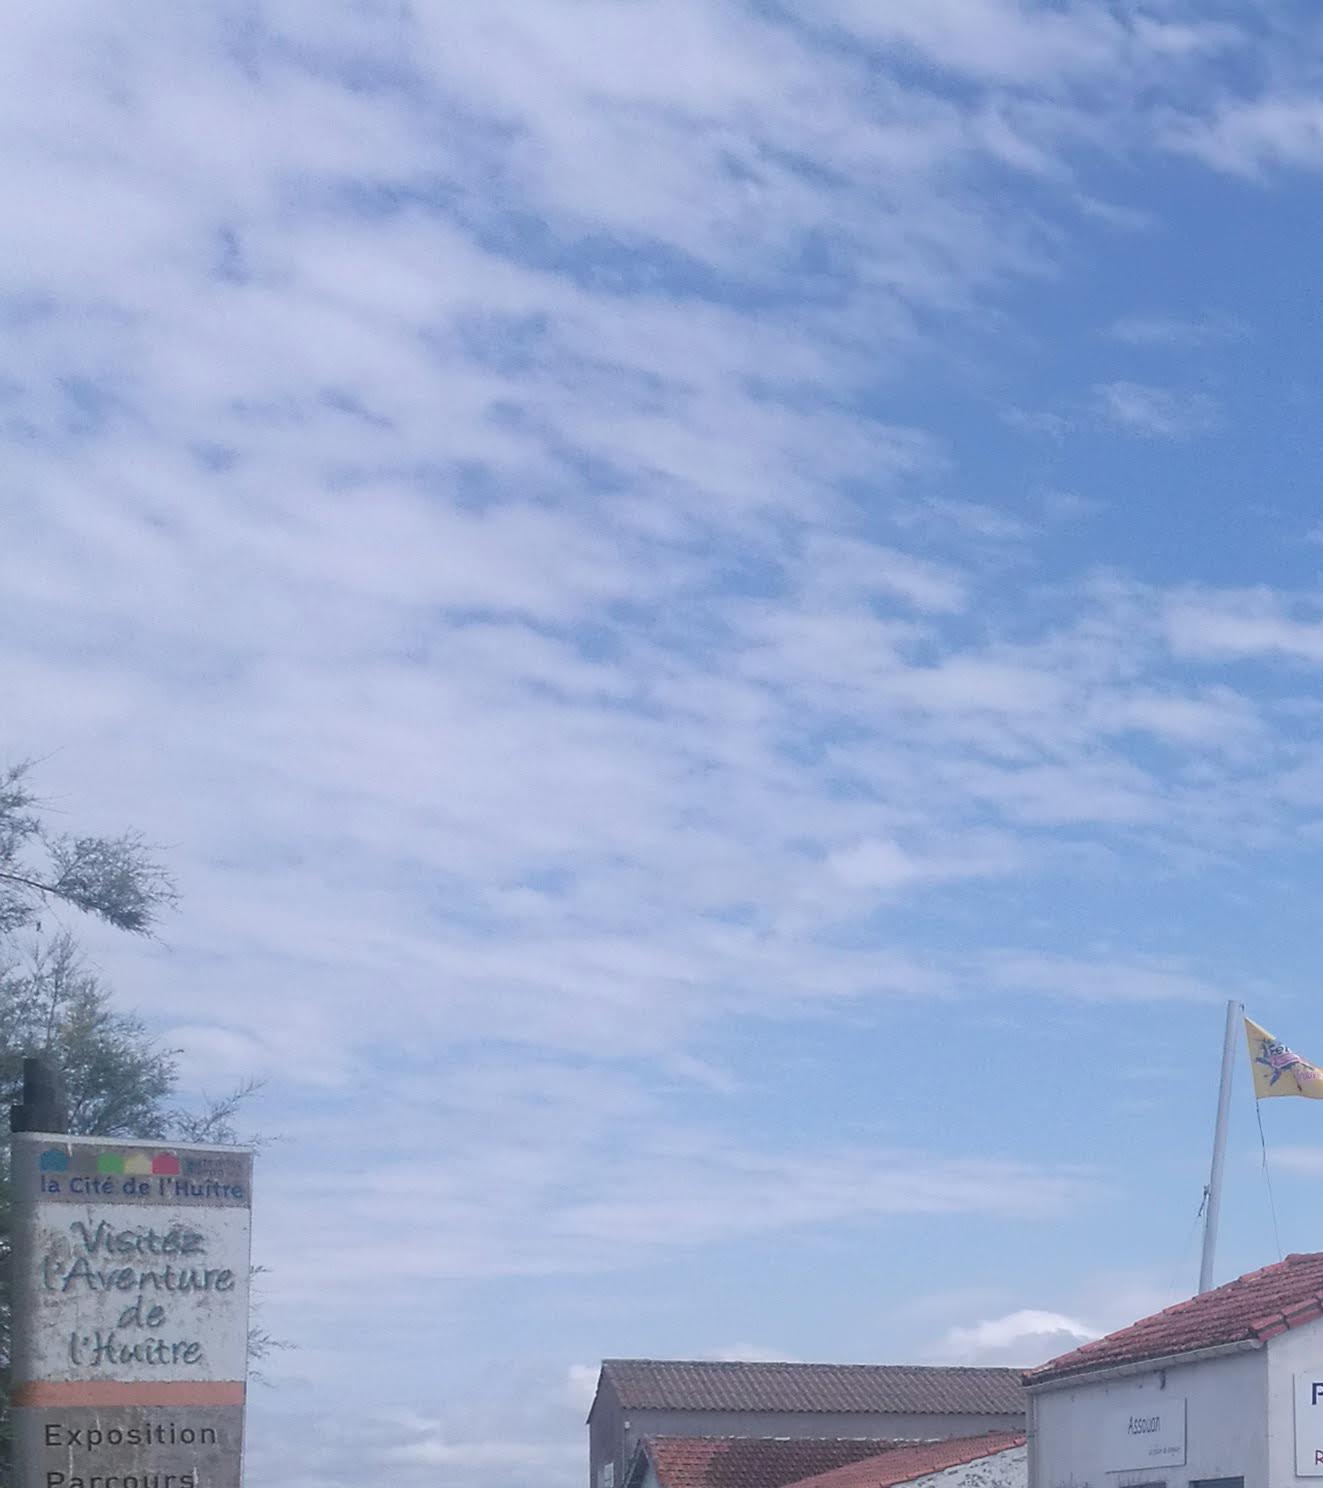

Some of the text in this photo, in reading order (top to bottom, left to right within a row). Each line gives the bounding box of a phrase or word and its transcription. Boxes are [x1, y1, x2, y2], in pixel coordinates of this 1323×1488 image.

[40, 1175, 244, 1198] la Cité de l'Huître
[70, 1219, 206, 1256] Visitez
[43, 1255, 235, 1292] l'Aventure
[117, 1294, 167, 1328] de
[70, 1332, 203, 1366] l'Huître
[45, 1422, 218, 1453] Exposition
